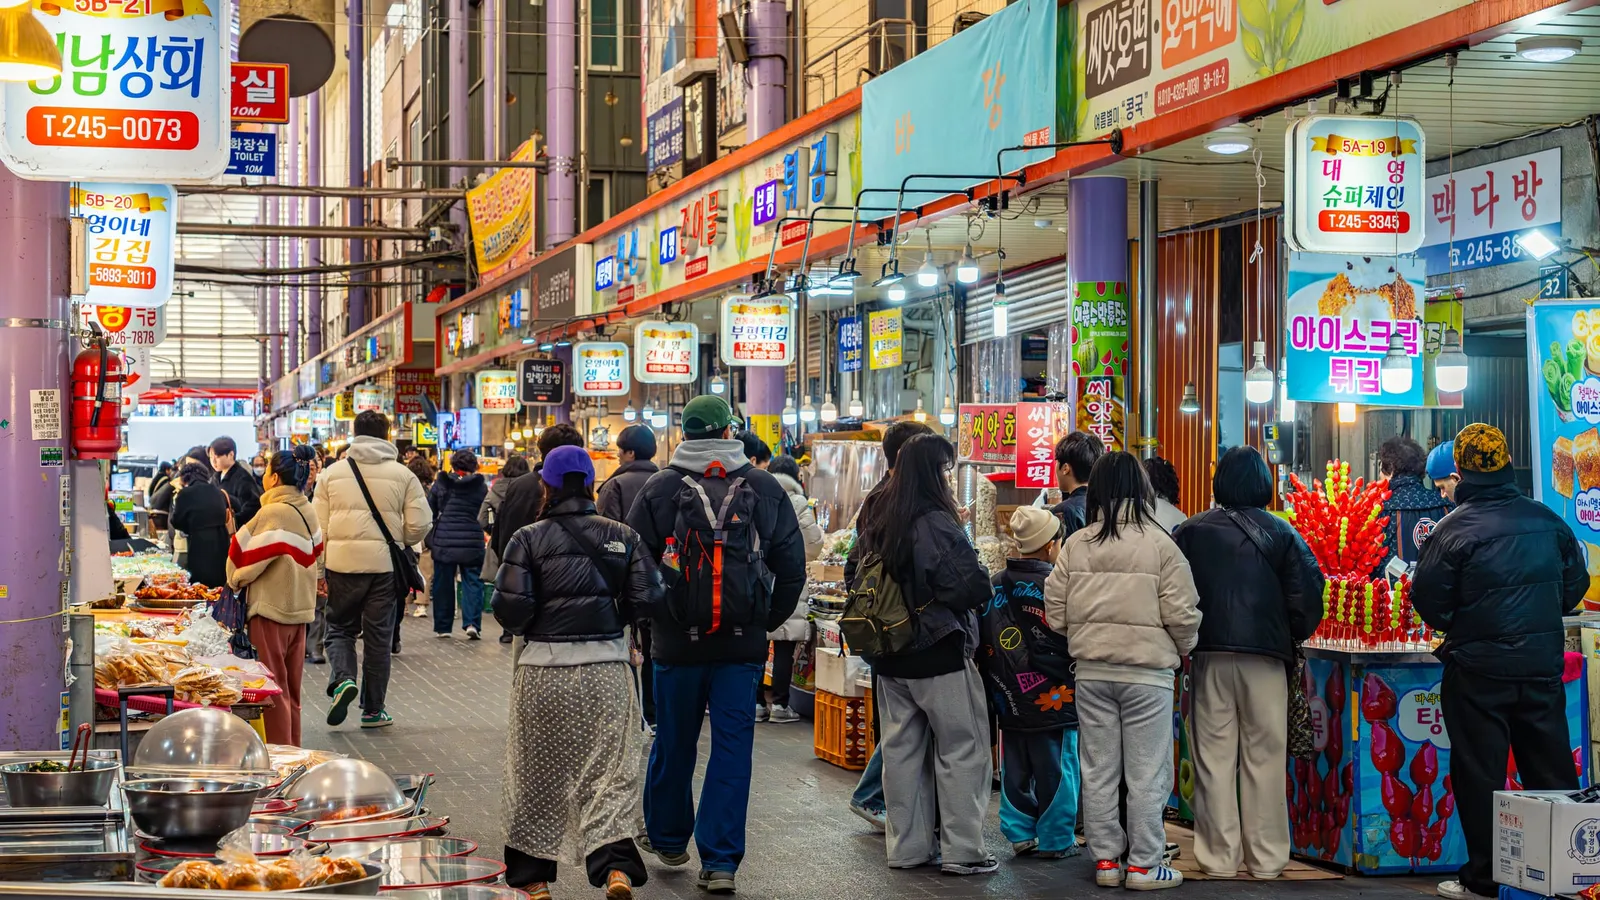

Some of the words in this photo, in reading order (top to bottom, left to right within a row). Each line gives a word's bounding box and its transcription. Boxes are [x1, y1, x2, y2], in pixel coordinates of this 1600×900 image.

[232, 106, 261, 116] 10M
[43, 114, 182, 142] T.245-0073
[230, 138, 268, 152] 화장실
[1343, 140, 1386, 154] 5A-19
[235, 152, 264, 161] TOILET
[245, 164, 263, 173] 10M
[782, 134, 828, 211] 튀김
[86, 194, 133, 209] 5B-20
[755, 183, 776, 221] 부평
[1323, 185, 1405, 210] 슈퍼체인
[1329, 213, 1400, 229] T.245-3345
[1545, 277, 1560, 296] 32
[731, 326, 788, 340] 부평튀김
[1292, 317, 1419, 355] 아이스크림
[1331, 358, 1380, 394] 튀김
[1578, 385, 1600, 401] 철판수
[1576, 401, 1600, 414] 아이스
[1088, 381, 1115, 452] 씨앗호
[1027, 406, 1054, 485] 씨앗호떡
[1577, 498, 1600, 511] 마시멜
